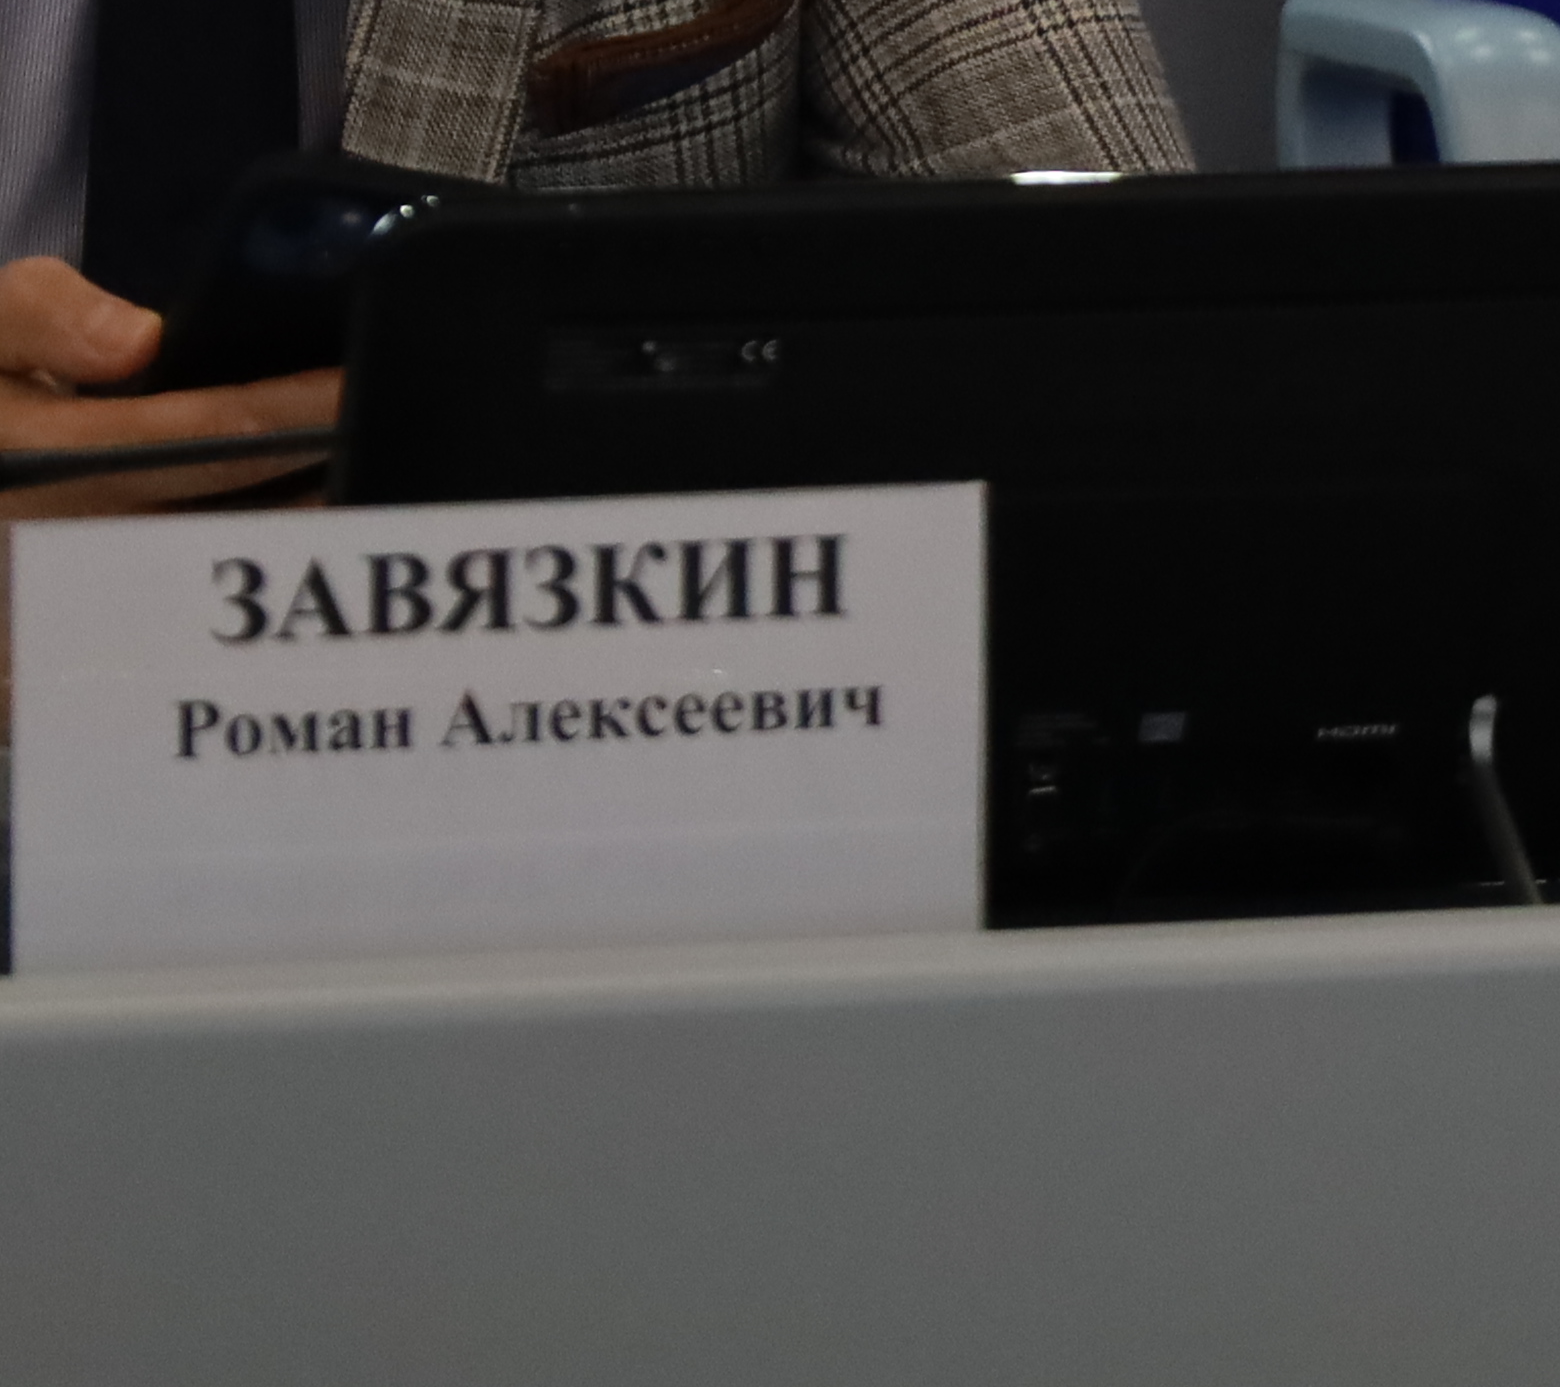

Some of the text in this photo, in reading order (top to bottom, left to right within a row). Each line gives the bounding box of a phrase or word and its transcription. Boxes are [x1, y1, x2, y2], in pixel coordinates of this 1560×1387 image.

[212, 533, 846, 645] ЗАВЯЗКИН
[176, 685, 883, 760] Роман Алексеевич
